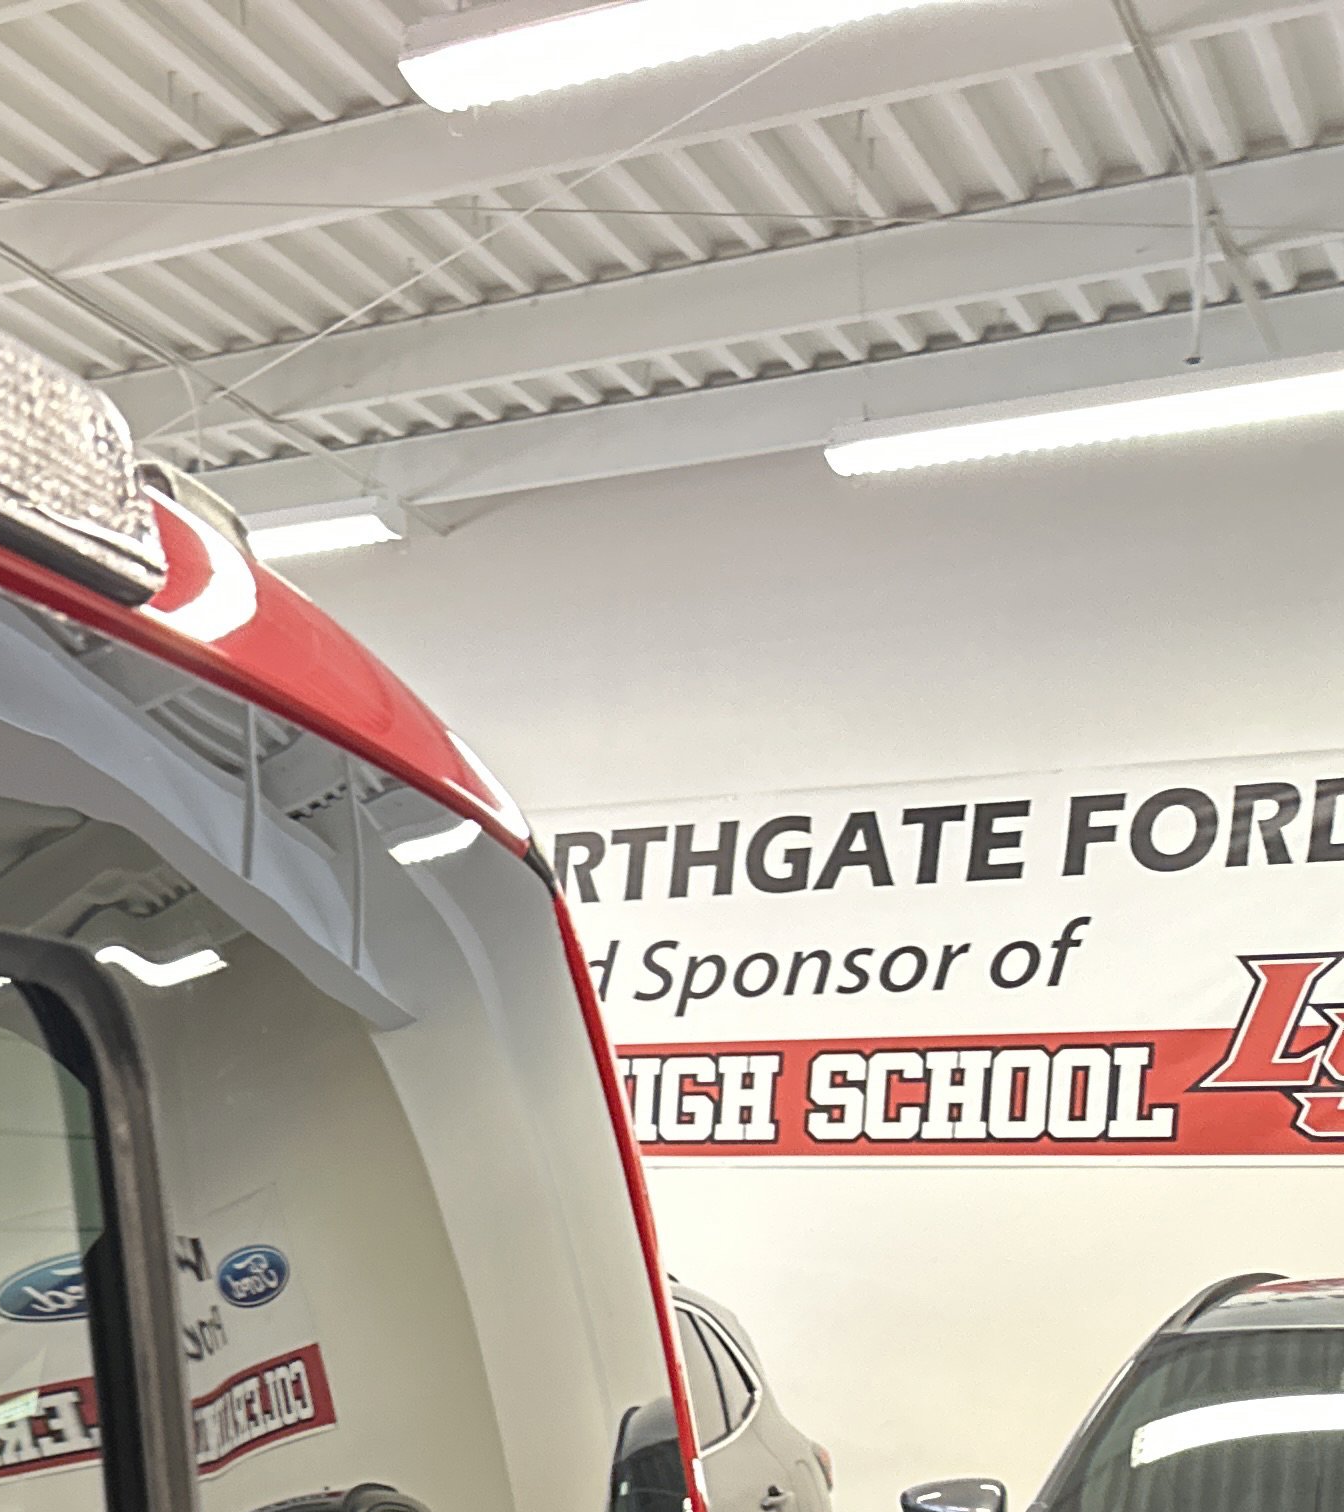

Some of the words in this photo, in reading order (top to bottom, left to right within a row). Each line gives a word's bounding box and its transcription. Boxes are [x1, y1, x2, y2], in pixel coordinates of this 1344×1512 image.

[633, 939, 971, 1018] Sponsor
[991, 916, 1091, 989] of
[615, 1052, 783, 1144] IGH
[806, 1043, 1180, 1144] SCHOOL
